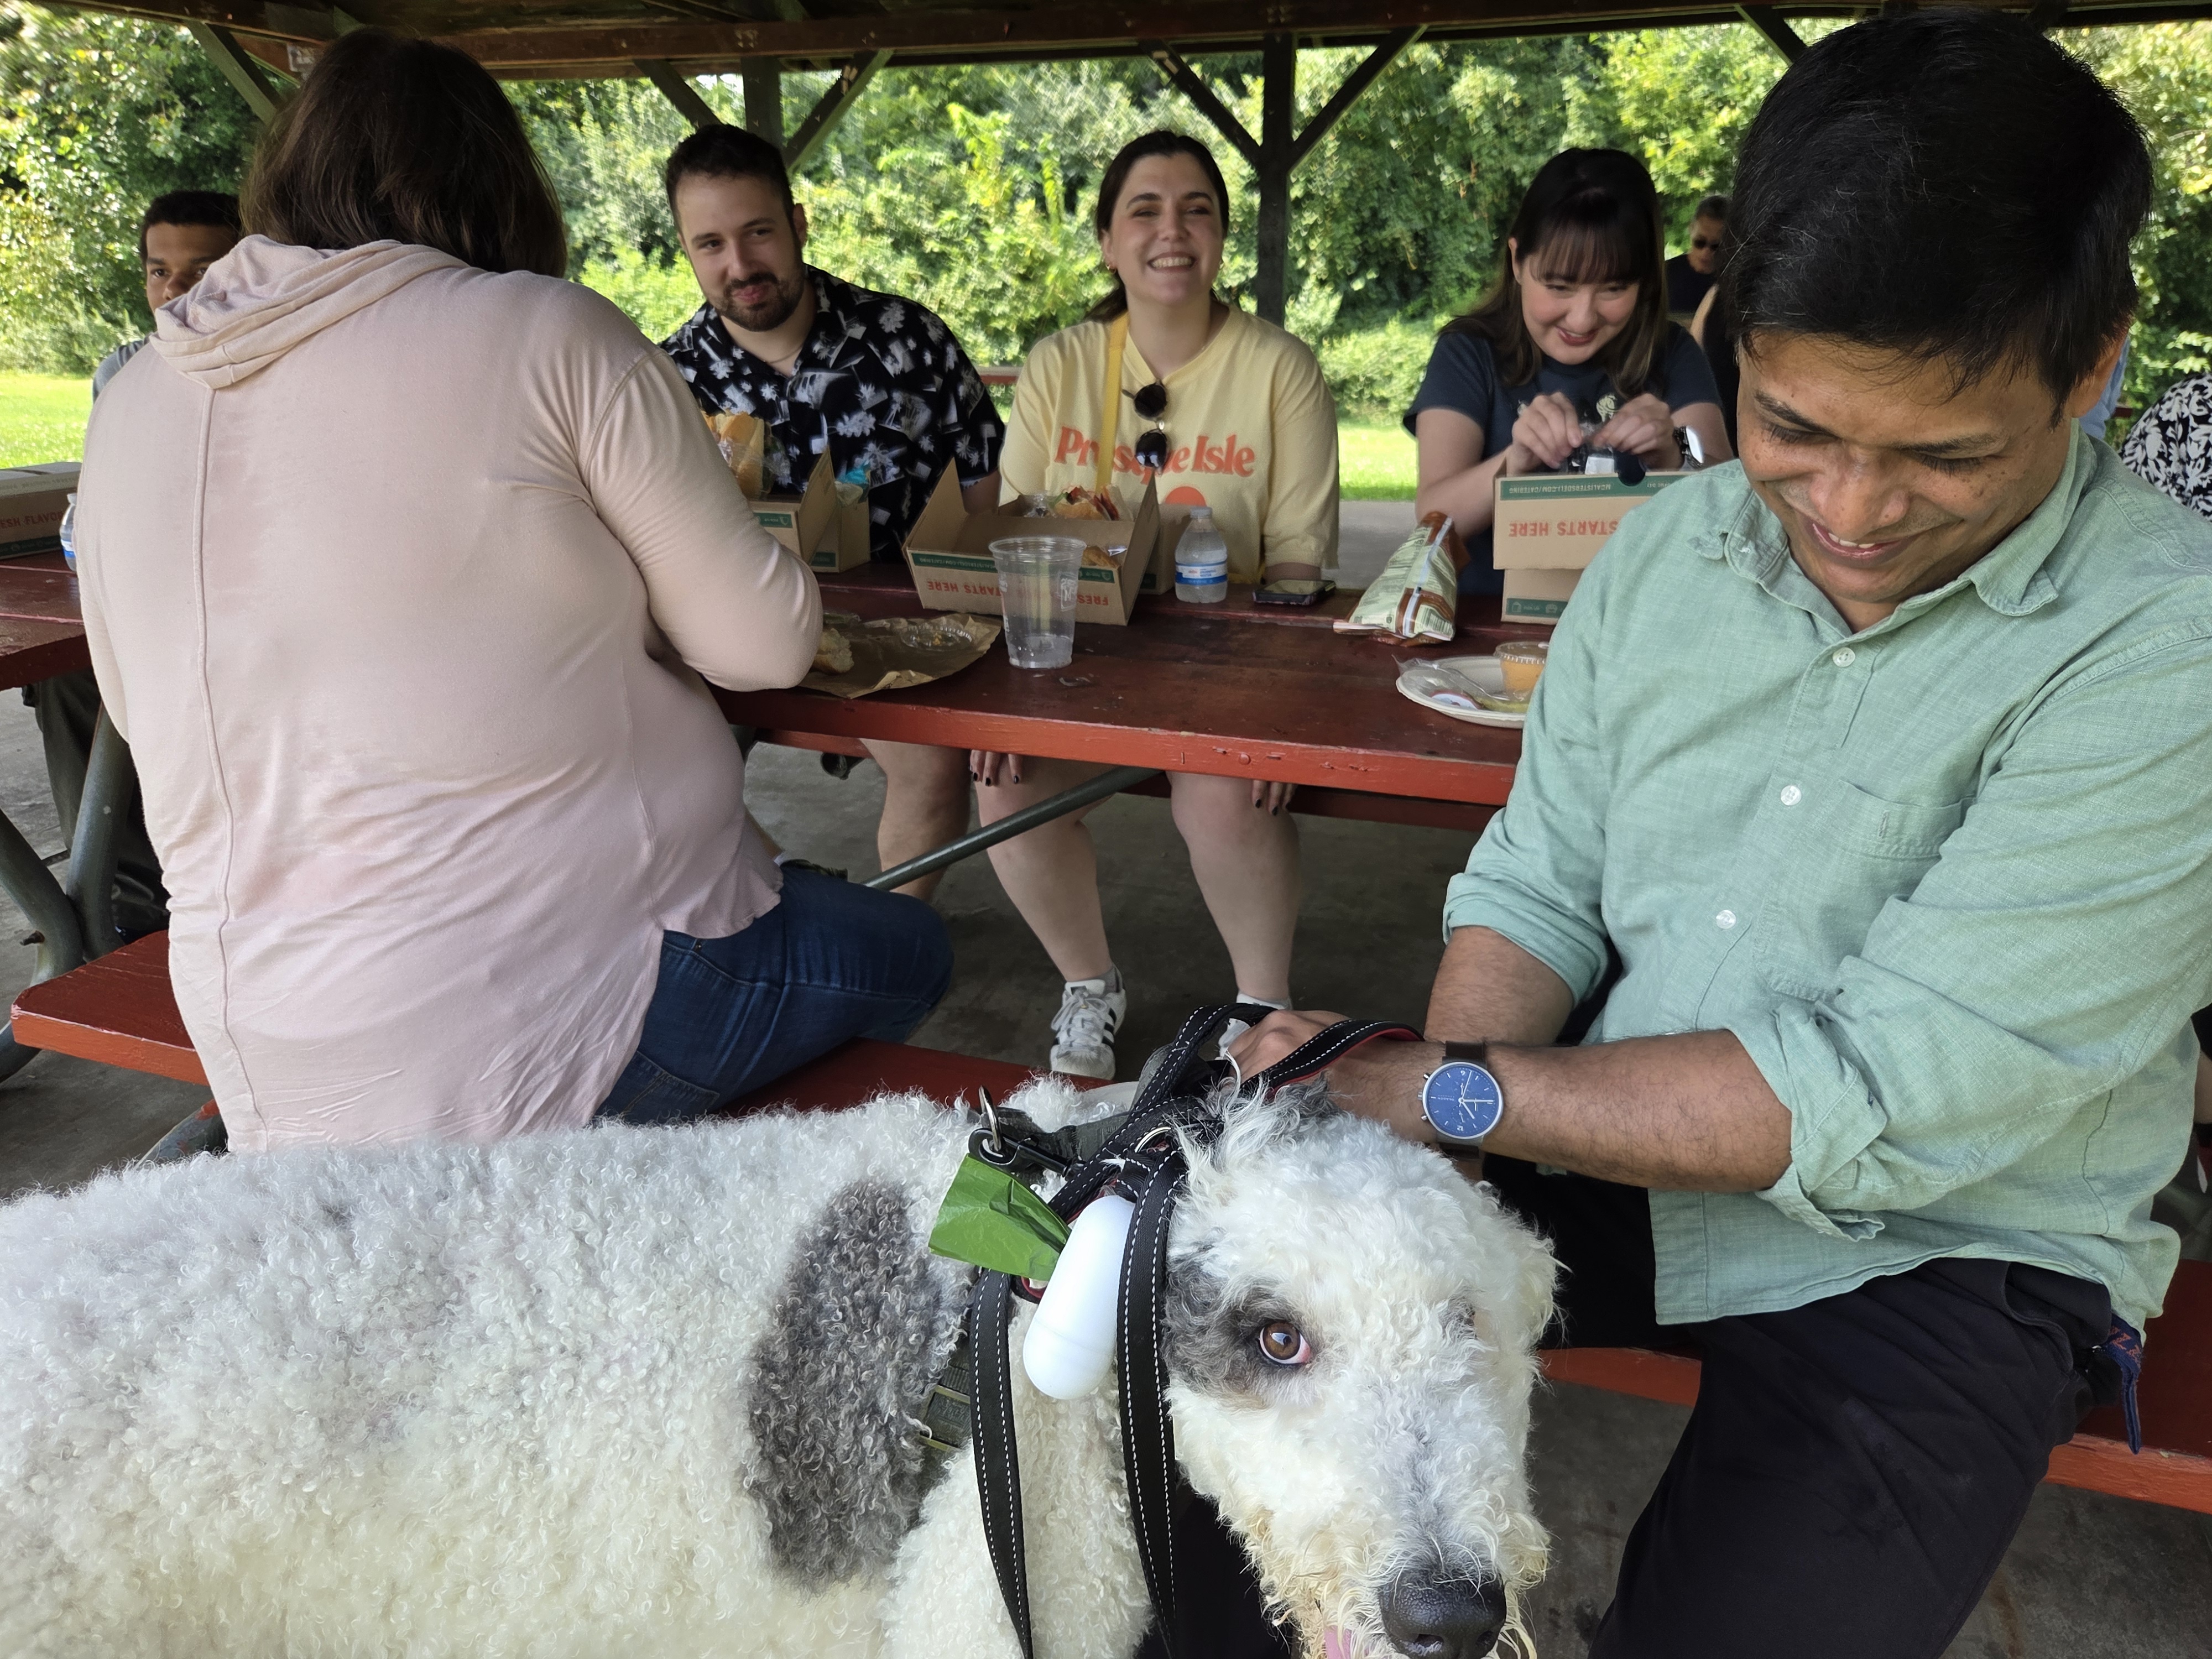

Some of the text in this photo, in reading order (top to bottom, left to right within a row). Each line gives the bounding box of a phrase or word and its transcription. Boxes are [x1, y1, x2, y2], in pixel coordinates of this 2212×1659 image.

[1191, 434, 1255, 477] Isle
[1509, 484, 1611, 494] MCALISTERSDELI.COM/CATERING
[1508, 520, 1619, 537] STARTS HERE
[927, 581, 1001, 597] TARTS HERE
[1076, 594, 1109, 606] FRES
